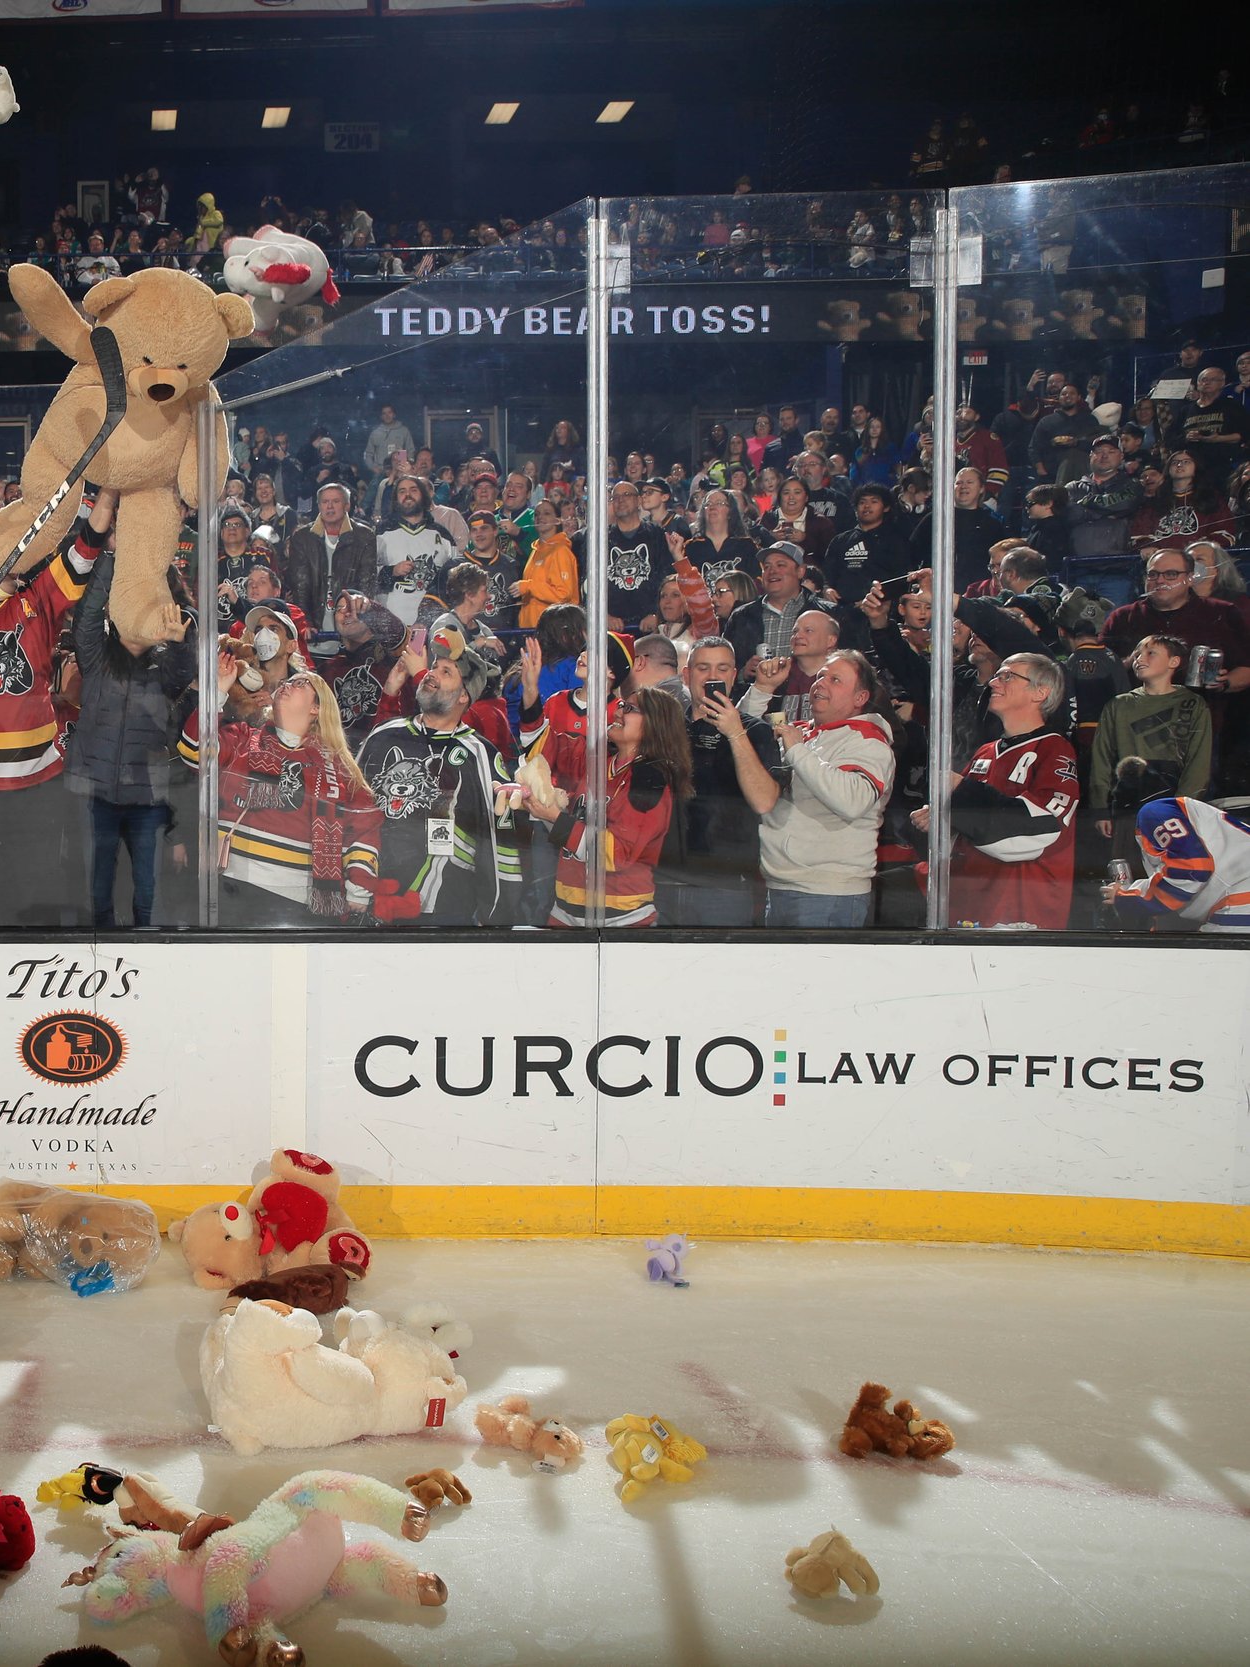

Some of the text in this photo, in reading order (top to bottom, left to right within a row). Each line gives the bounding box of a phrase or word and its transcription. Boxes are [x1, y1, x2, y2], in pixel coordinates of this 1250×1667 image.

[333, 133, 373, 150] 204
[374, 307, 510, 335] TEDDY
[646, 305, 770, 334] TOSS!
[17, 480, 70, 552] CCM
[448, 745, 469, 766] C
[6, 953, 140, 1000] Tito's
[354, 1034, 764, 1098] CURCIO
[797, 1052, 1205, 1093] LAW OFFICES
[31, 1138, 115, 1153] VODKA
[8, 1161, 138, 1172] AUSTIN TEXAS
